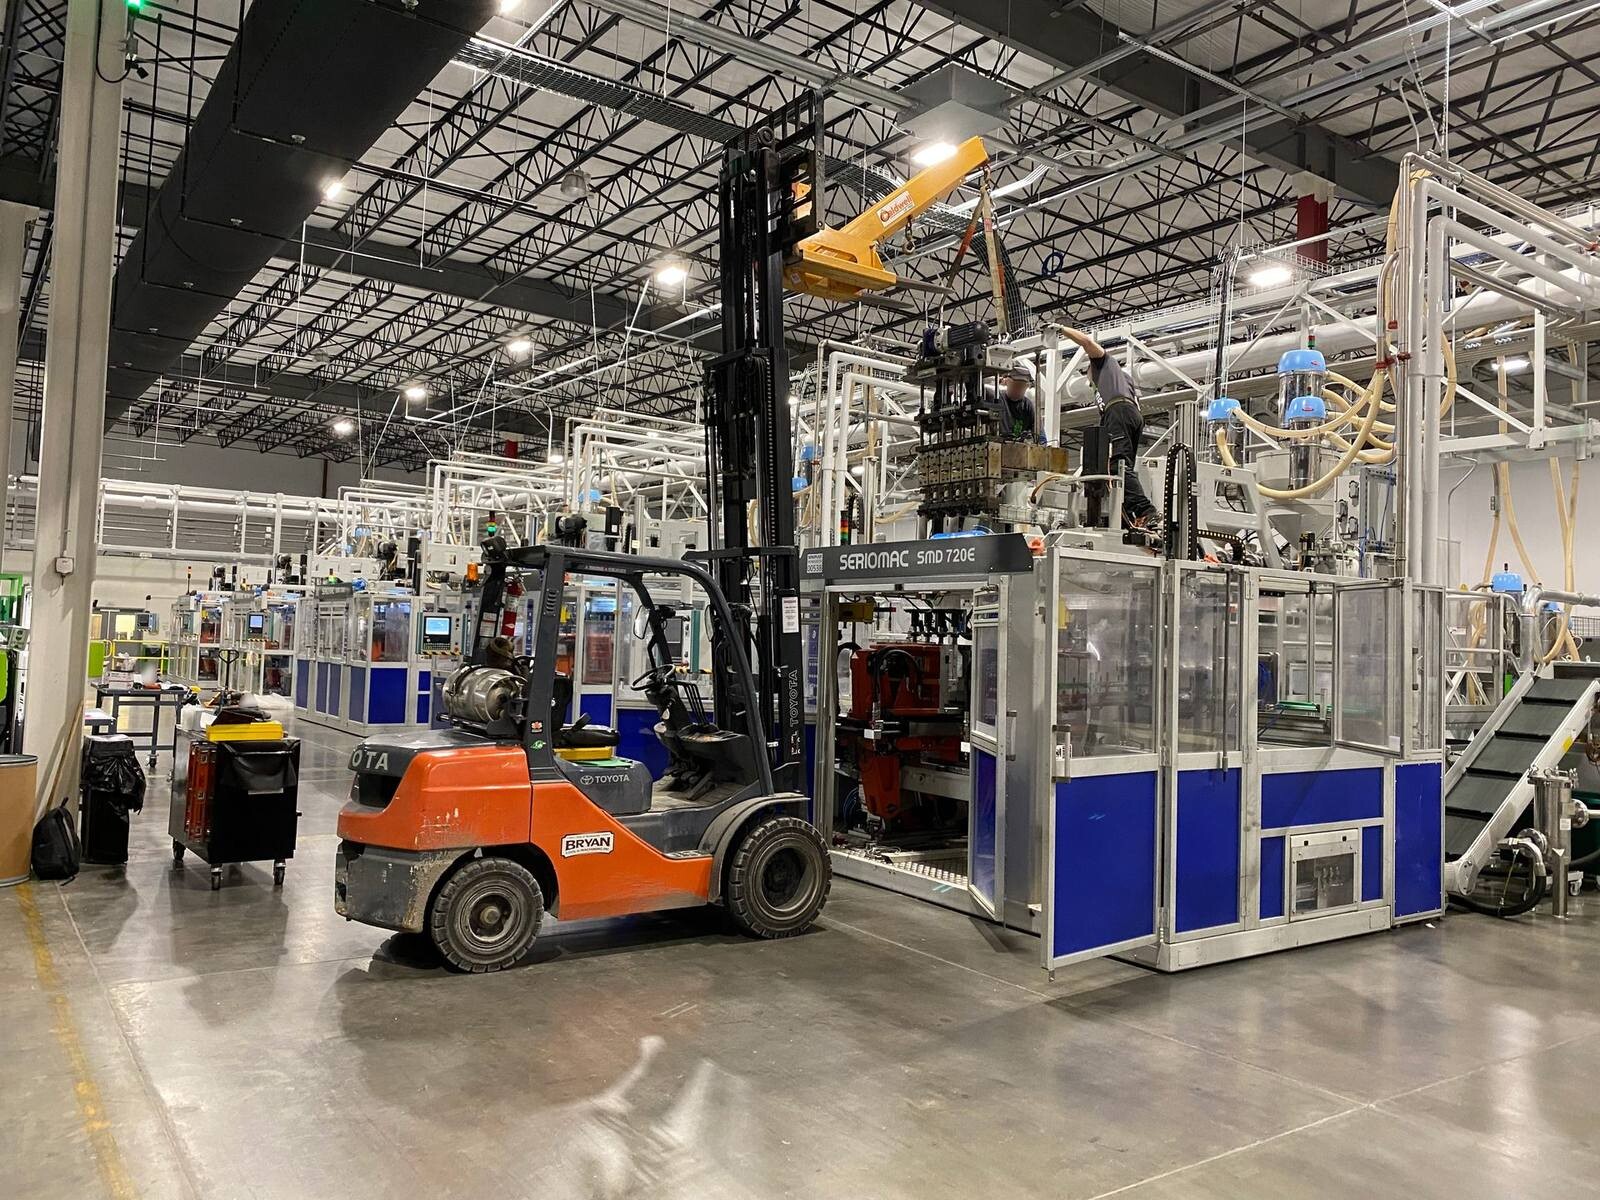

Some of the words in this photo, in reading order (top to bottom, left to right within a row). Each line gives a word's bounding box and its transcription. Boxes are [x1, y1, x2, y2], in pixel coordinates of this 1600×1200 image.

[840, 550, 909, 570] SERIOMAC
[917, 550, 943, 565] SMD
[946, 547, 976, 563] 720E
[789, 669, 799, 727] TOYOTA
[595, 774, 630, 783] TOYOTA
[566, 837, 610, 850] BRYAN
